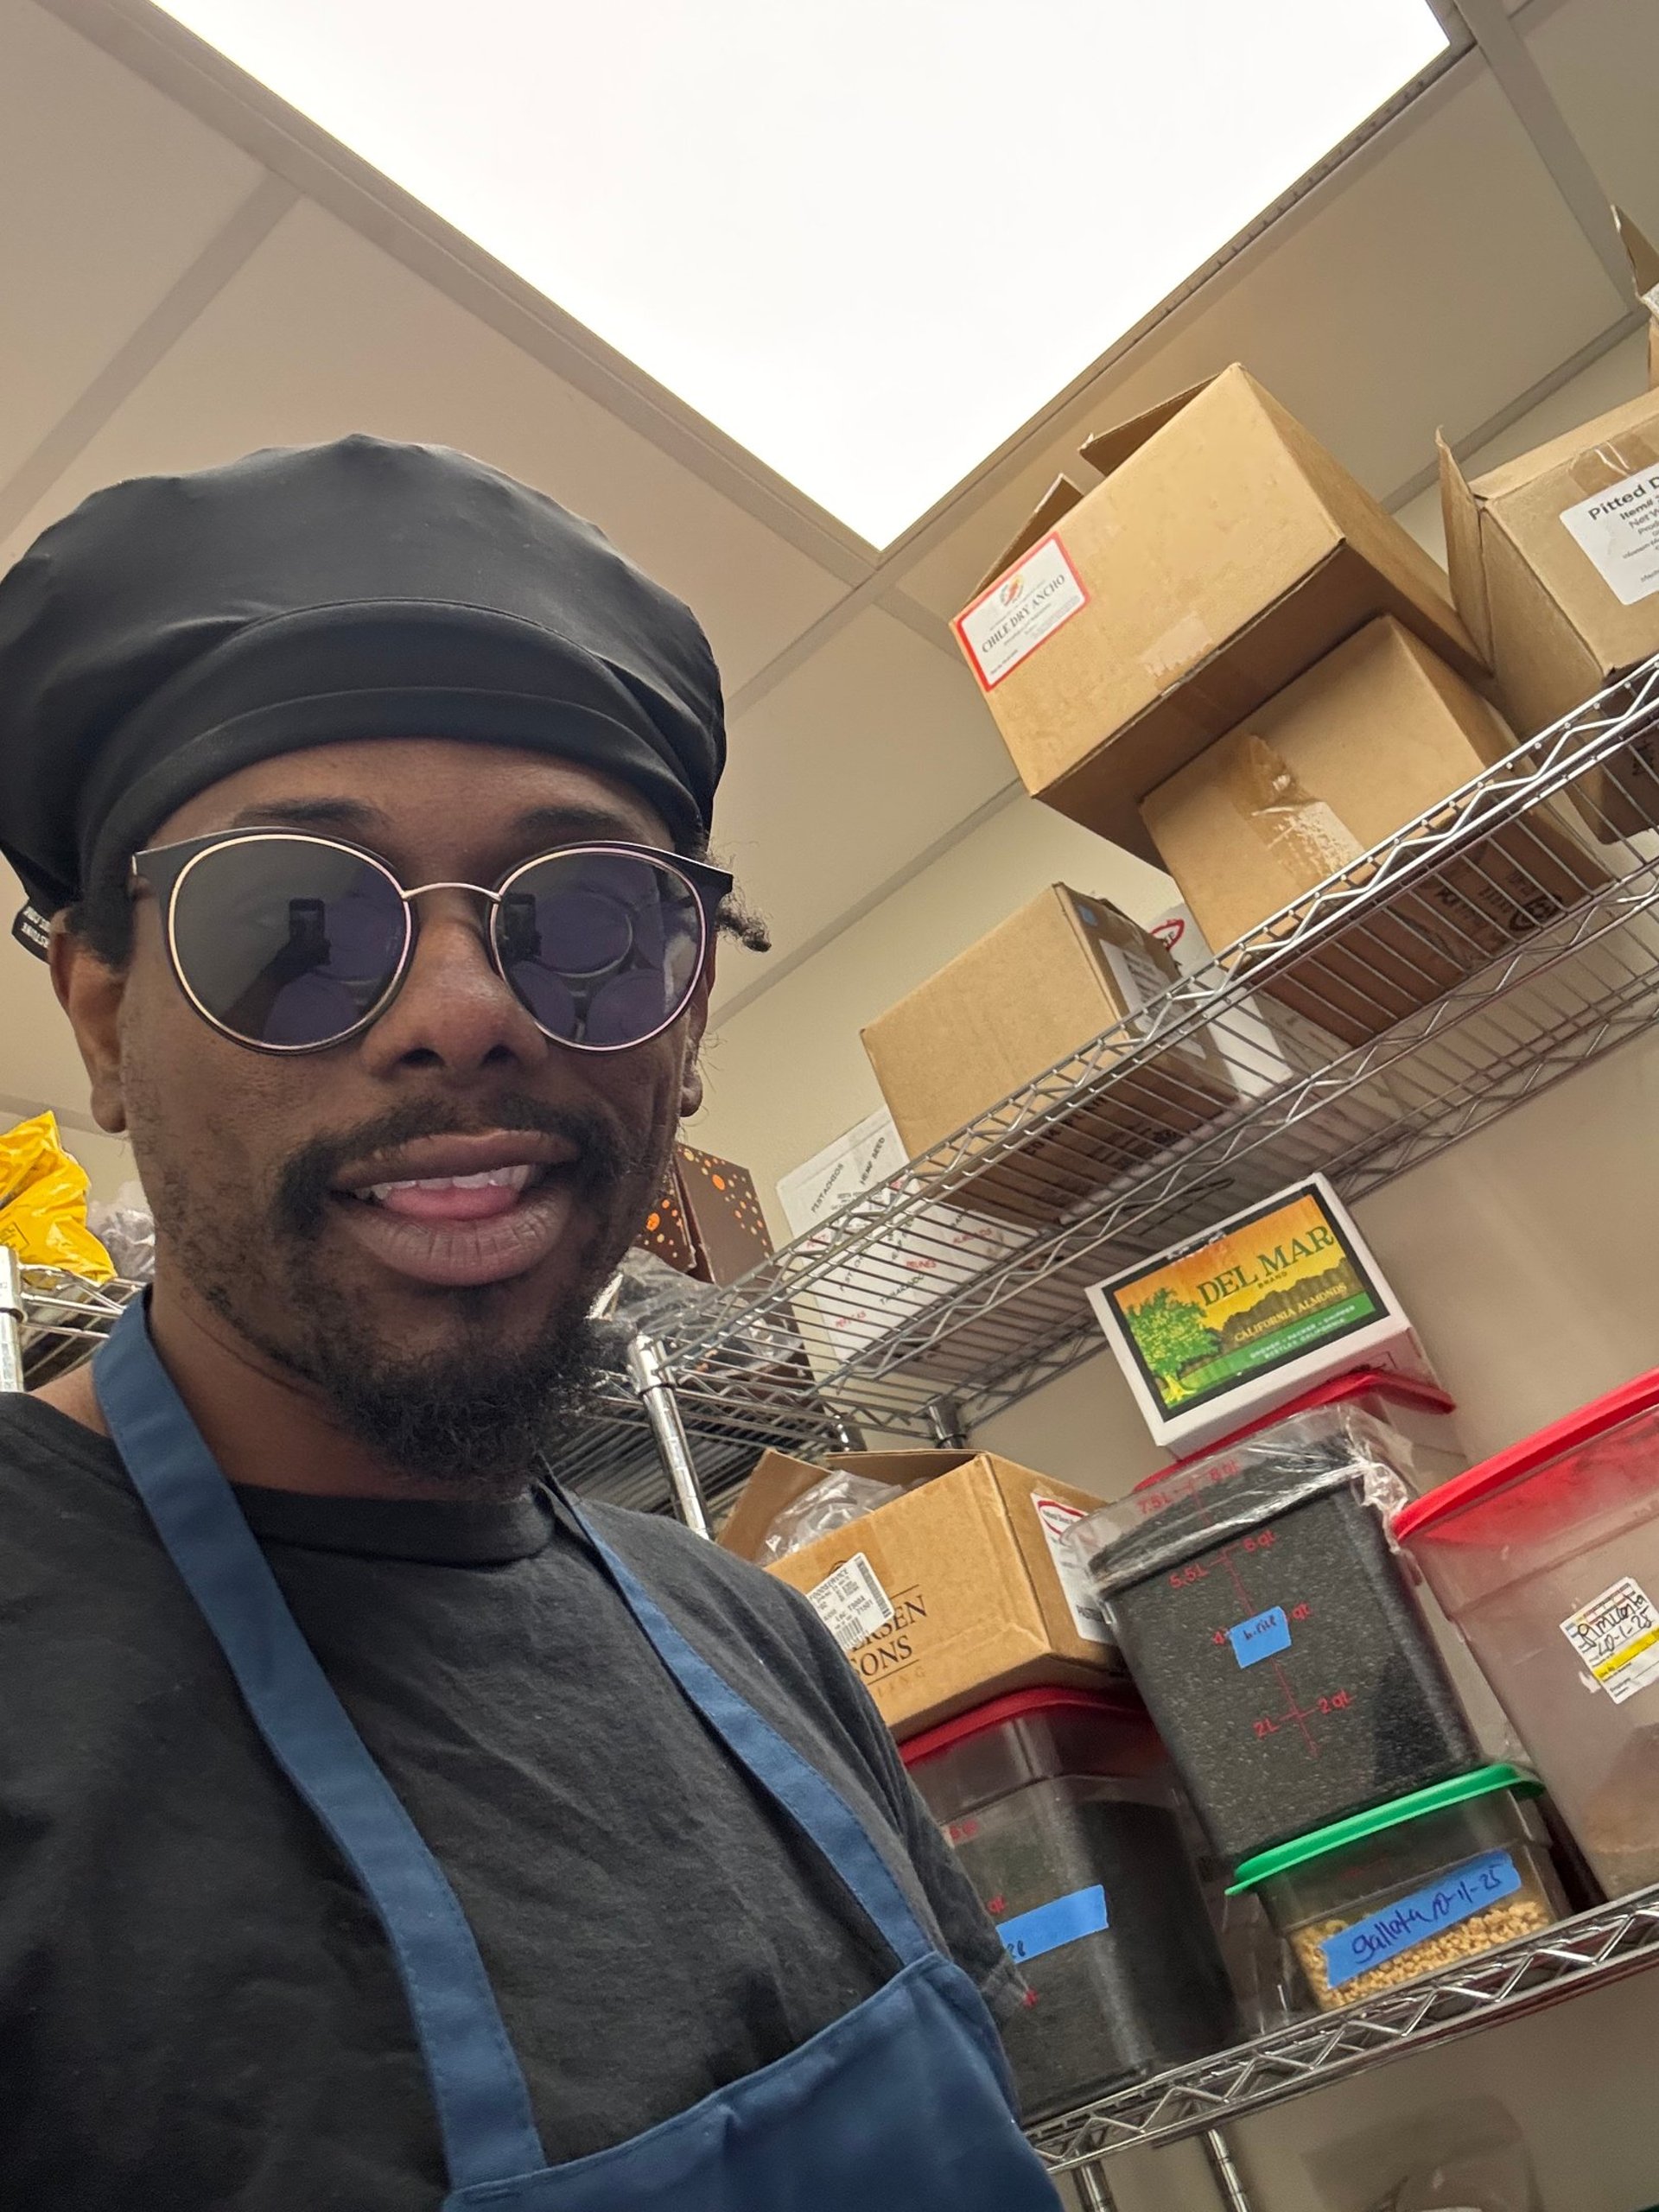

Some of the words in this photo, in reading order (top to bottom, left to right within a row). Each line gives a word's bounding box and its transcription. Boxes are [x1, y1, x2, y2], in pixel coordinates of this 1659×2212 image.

[1588, 484, 1646, 520] Pitted
[1620, 499, 1653, 520] Item#
[982, 623, 1009, 653] CHILE
[1010, 607, 1032, 629] DRY
[1032, 574, 1065, 607] ANCHO
[1197, 1268, 1259, 1306] DEL
[1257, 1226, 1334, 1275] MAR
[1257, 1271, 1287, 1288] BRAND
[1234, 1307, 1296, 1343] CALIFORNIA
[1296, 1282, 1348, 1315] ALMONDS
[1169, 1566, 1209, 1590] 5.5L
[1253, 1721, 1280, 1739] 2L
[1317, 1699, 1331, 1715] 2
[1331, 1689, 1354, 1710] qt
